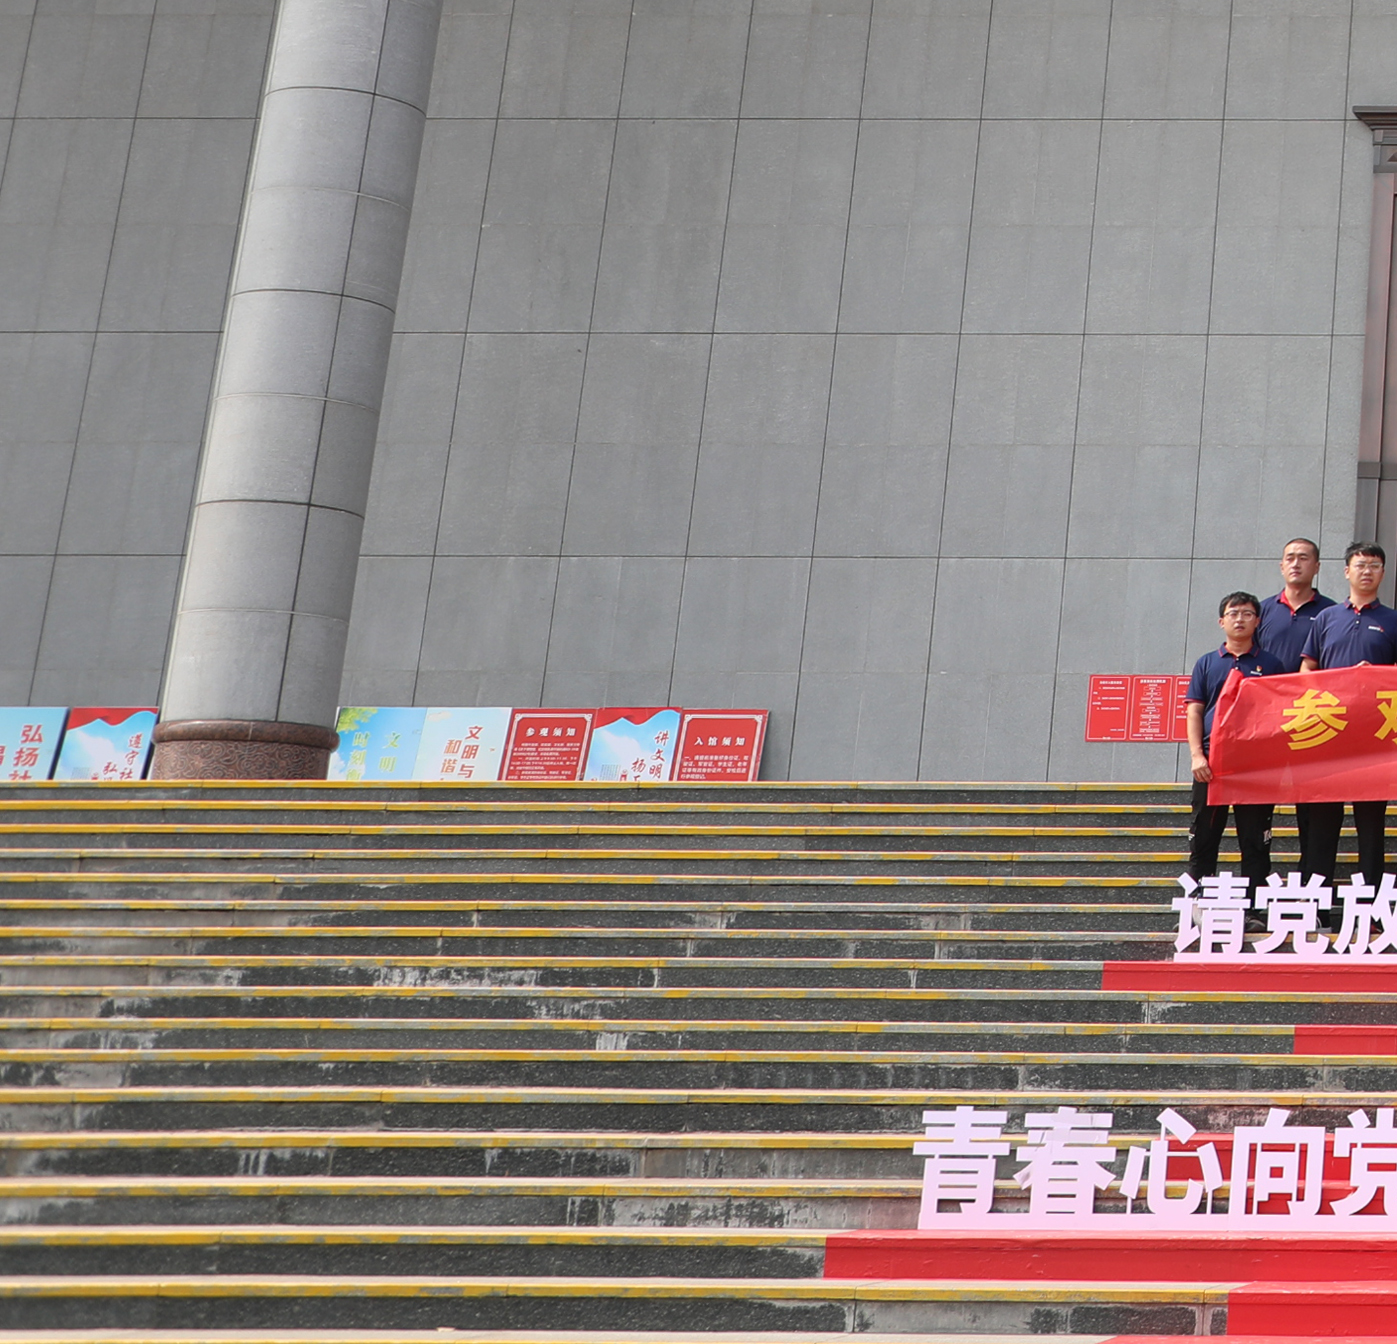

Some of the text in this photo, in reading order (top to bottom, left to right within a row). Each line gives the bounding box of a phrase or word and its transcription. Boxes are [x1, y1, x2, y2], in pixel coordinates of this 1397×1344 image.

[525, 727, 576, 737] 参观须知
[694, 736, 746, 747] 入馆须知
